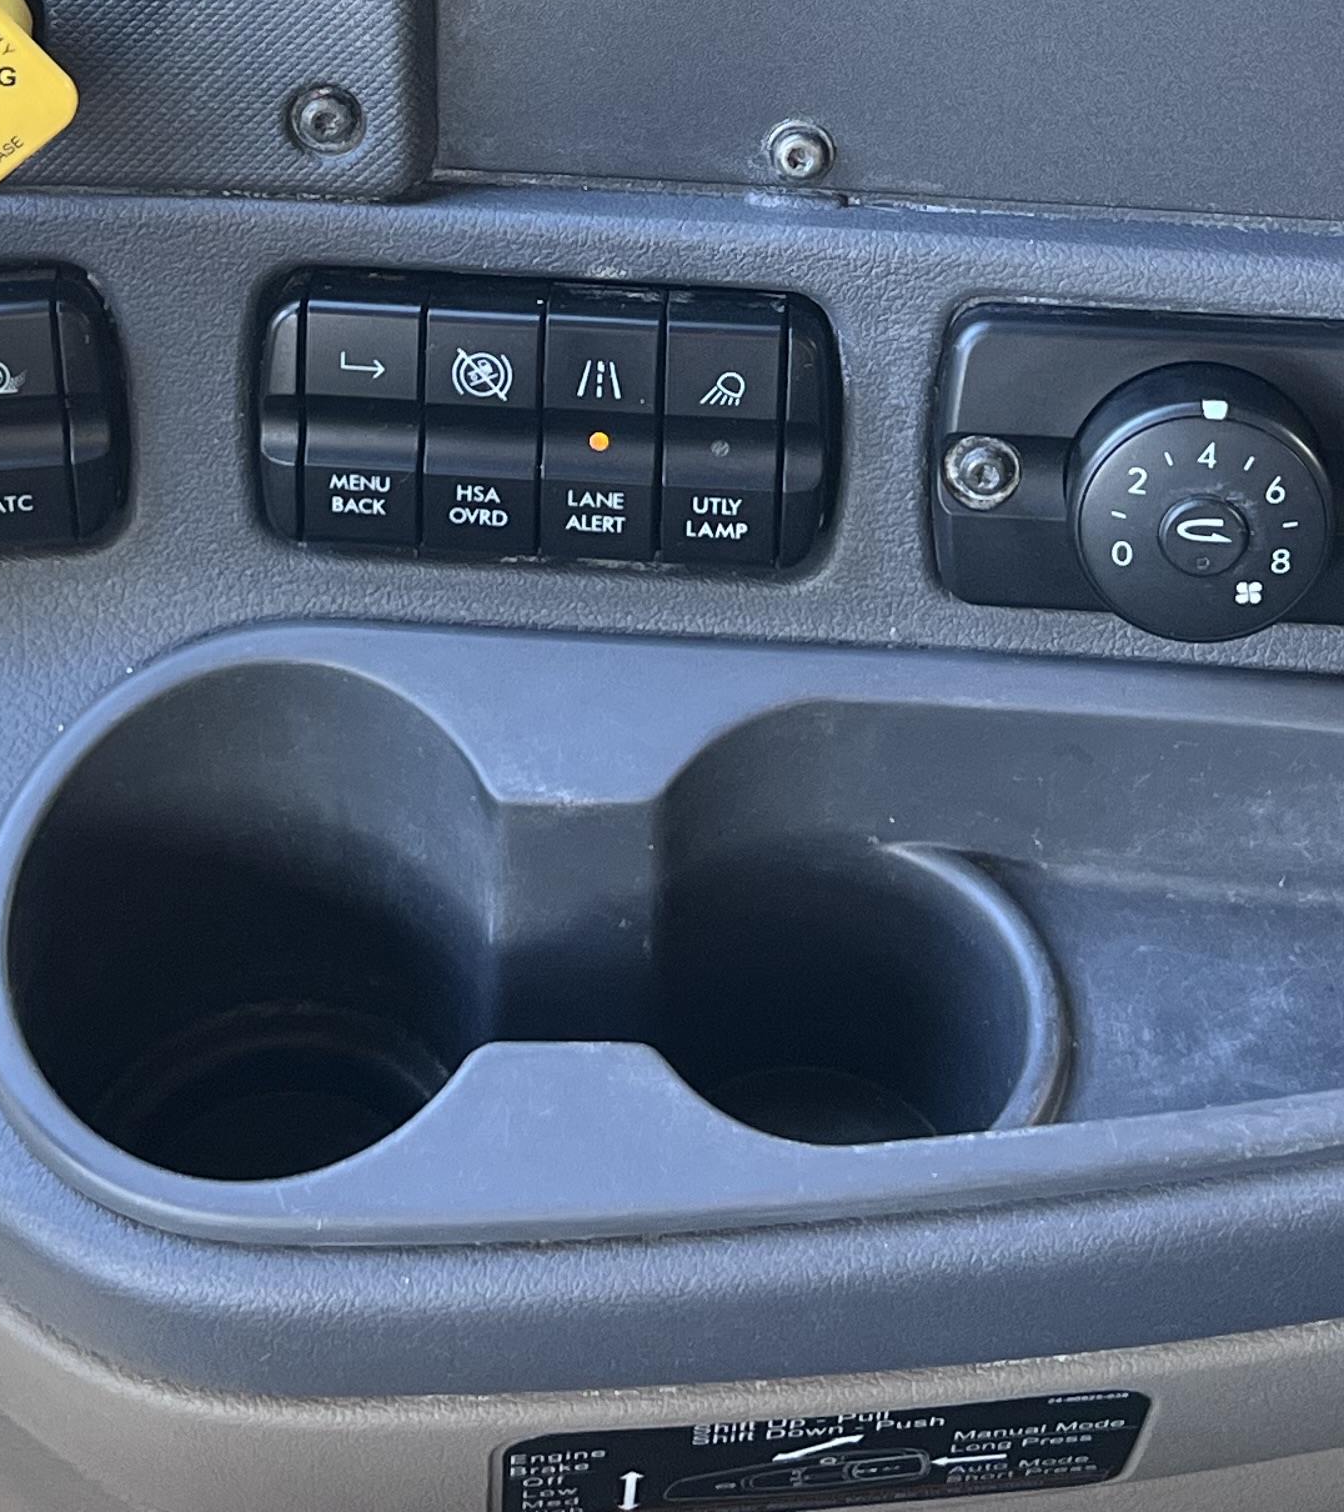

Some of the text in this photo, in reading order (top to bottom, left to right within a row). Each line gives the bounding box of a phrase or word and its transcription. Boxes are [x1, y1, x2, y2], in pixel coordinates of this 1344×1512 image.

[1197, 442, 1217, 468] 4
[329, 474, 391, 493] MENU
[1128, 467, 1148, 495] 2
[1265, 476, 1286, 504] 6
[457, 484, 501, 504] HSA
[567, 490, 625, 511] LANE
[331, 496, 386, 516] BACK
[692, 496, 742, 516] UTLY
[449, 506, 508, 528] OVRD
[565, 514, 625, 534] ALERT
[686, 520, 748, 540] LAMP
[1111, 540, 1132, 567] 0
[1270, 548, 1291, 575] 8
[766, 1425, 844, 1440] Down
[876, 1416, 945, 1432] Push
[954, 1418, 1126, 1440] Manual Mode
[951, 1434, 1093, 1453] Long Press
[510, 1449, 606, 1466] Engine
[948, 1455, 1089, 1475] Auto Mode
[510, 1462, 589, 1478] Brake
[523, 1475, 565, 1488] Off
[522, 1487, 578, 1500] Low
[522, 1496, 579, 1511] Med
